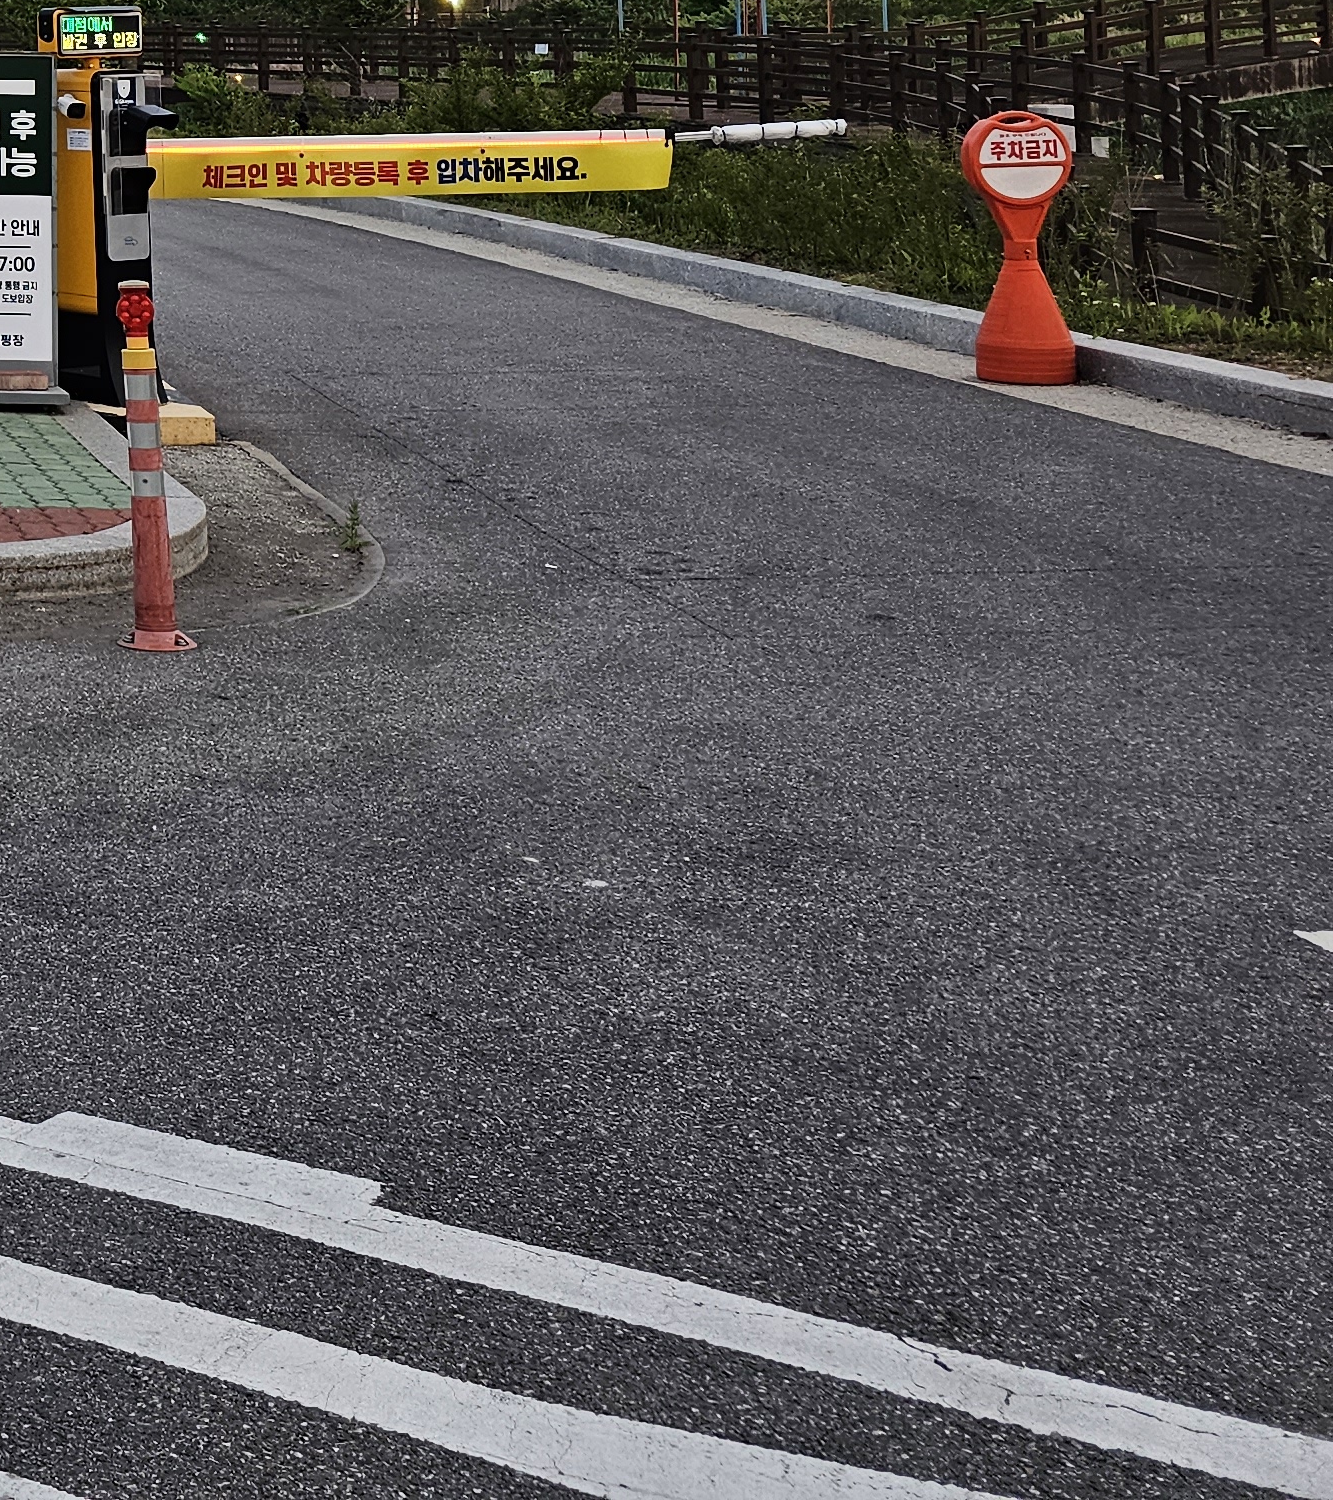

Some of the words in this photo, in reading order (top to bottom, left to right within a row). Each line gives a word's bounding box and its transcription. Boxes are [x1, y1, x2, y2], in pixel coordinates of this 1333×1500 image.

[9, 110, 37, 141] 후
[990, 139, 1058, 161] 주차금지
[202, 163, 268, 190] 체크인
[275, 163, 297, 188] 및
[305, 160, 400, 188] 차량등록
[406, 159, 429, 186] 후
[436, 157, 588, 185] 입차해주세요.
[11, 219, 39, 236] 안내
[22, 281, 37, 290] 금지
[2, 294, 33, 304] 도보입장
